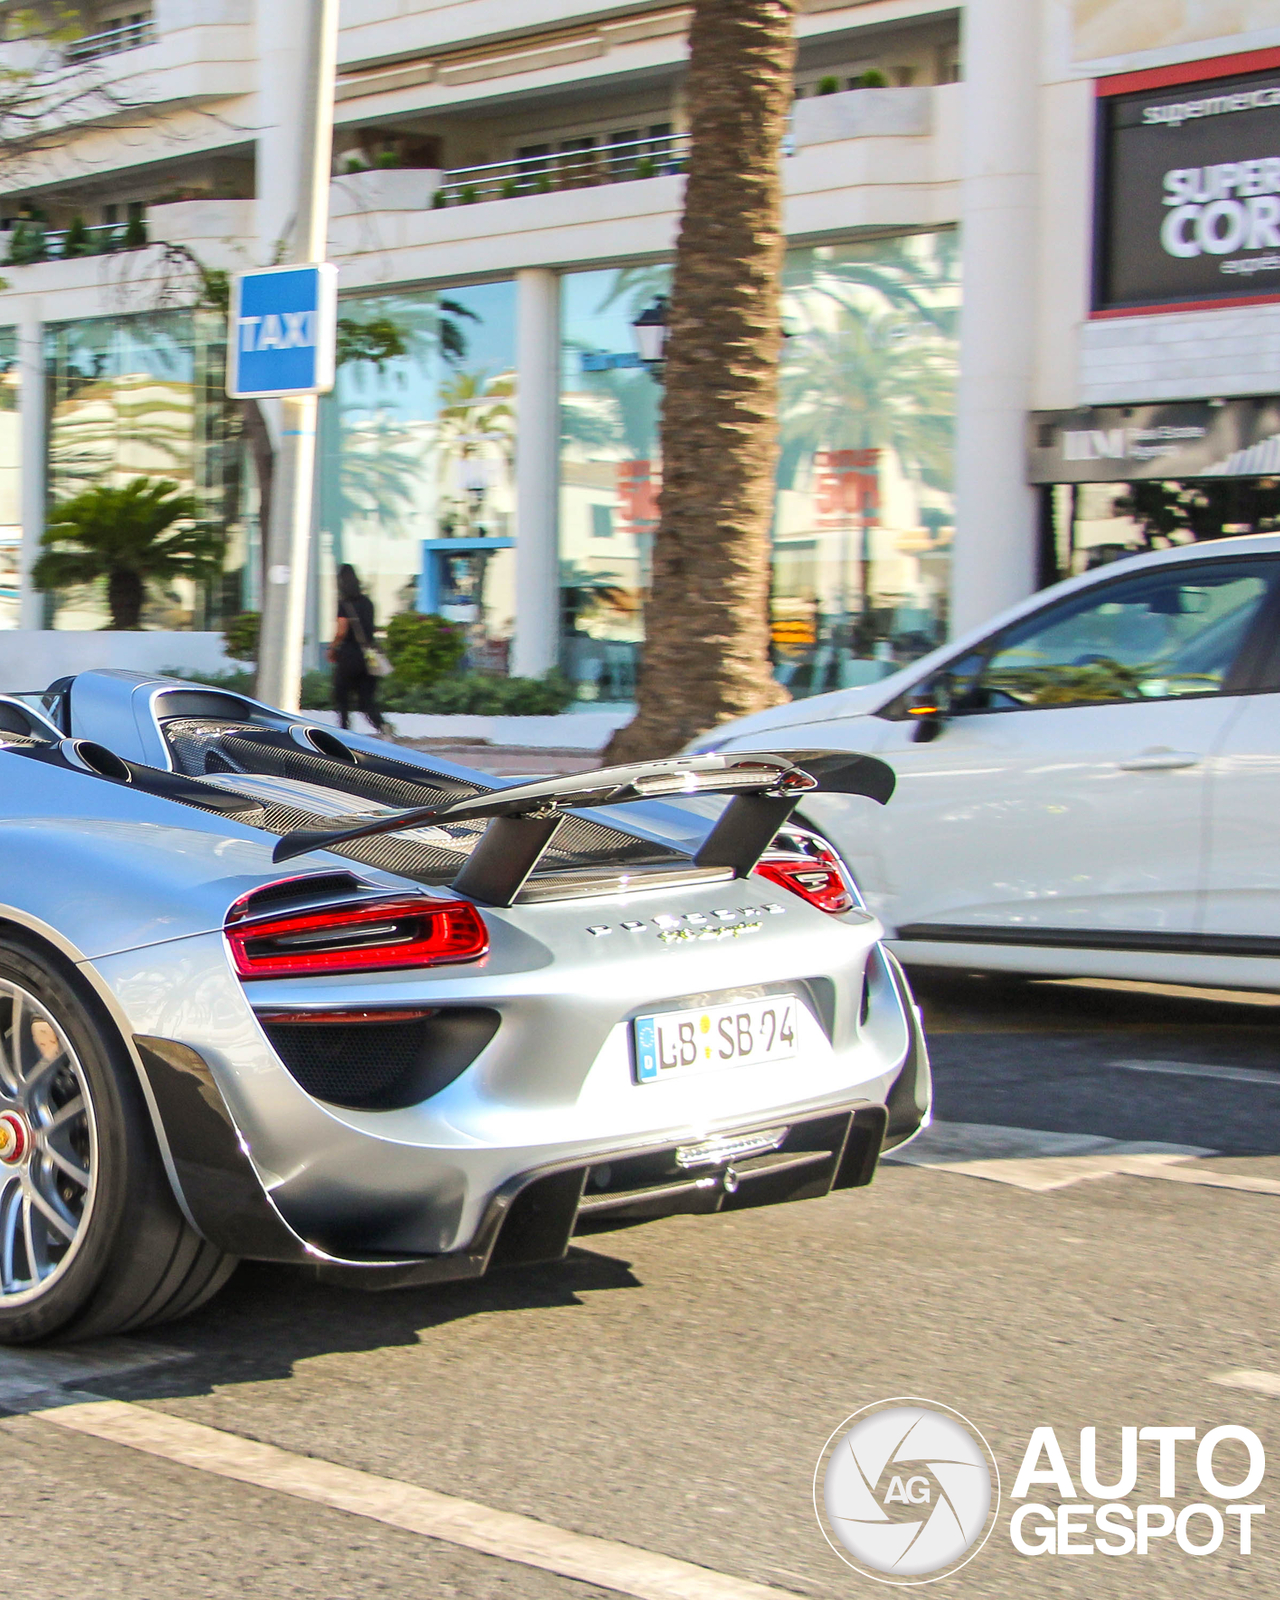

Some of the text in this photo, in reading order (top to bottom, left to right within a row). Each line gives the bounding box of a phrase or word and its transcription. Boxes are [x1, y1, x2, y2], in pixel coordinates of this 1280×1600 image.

[1161, 156, 1280, 206] SUPER
[1160, 195, 1280, 258] COR
[236, 310, 318, 353] TAXI
[658, 1021, 697, 1070] LB
[718, 1013, 754, 1060] SB
